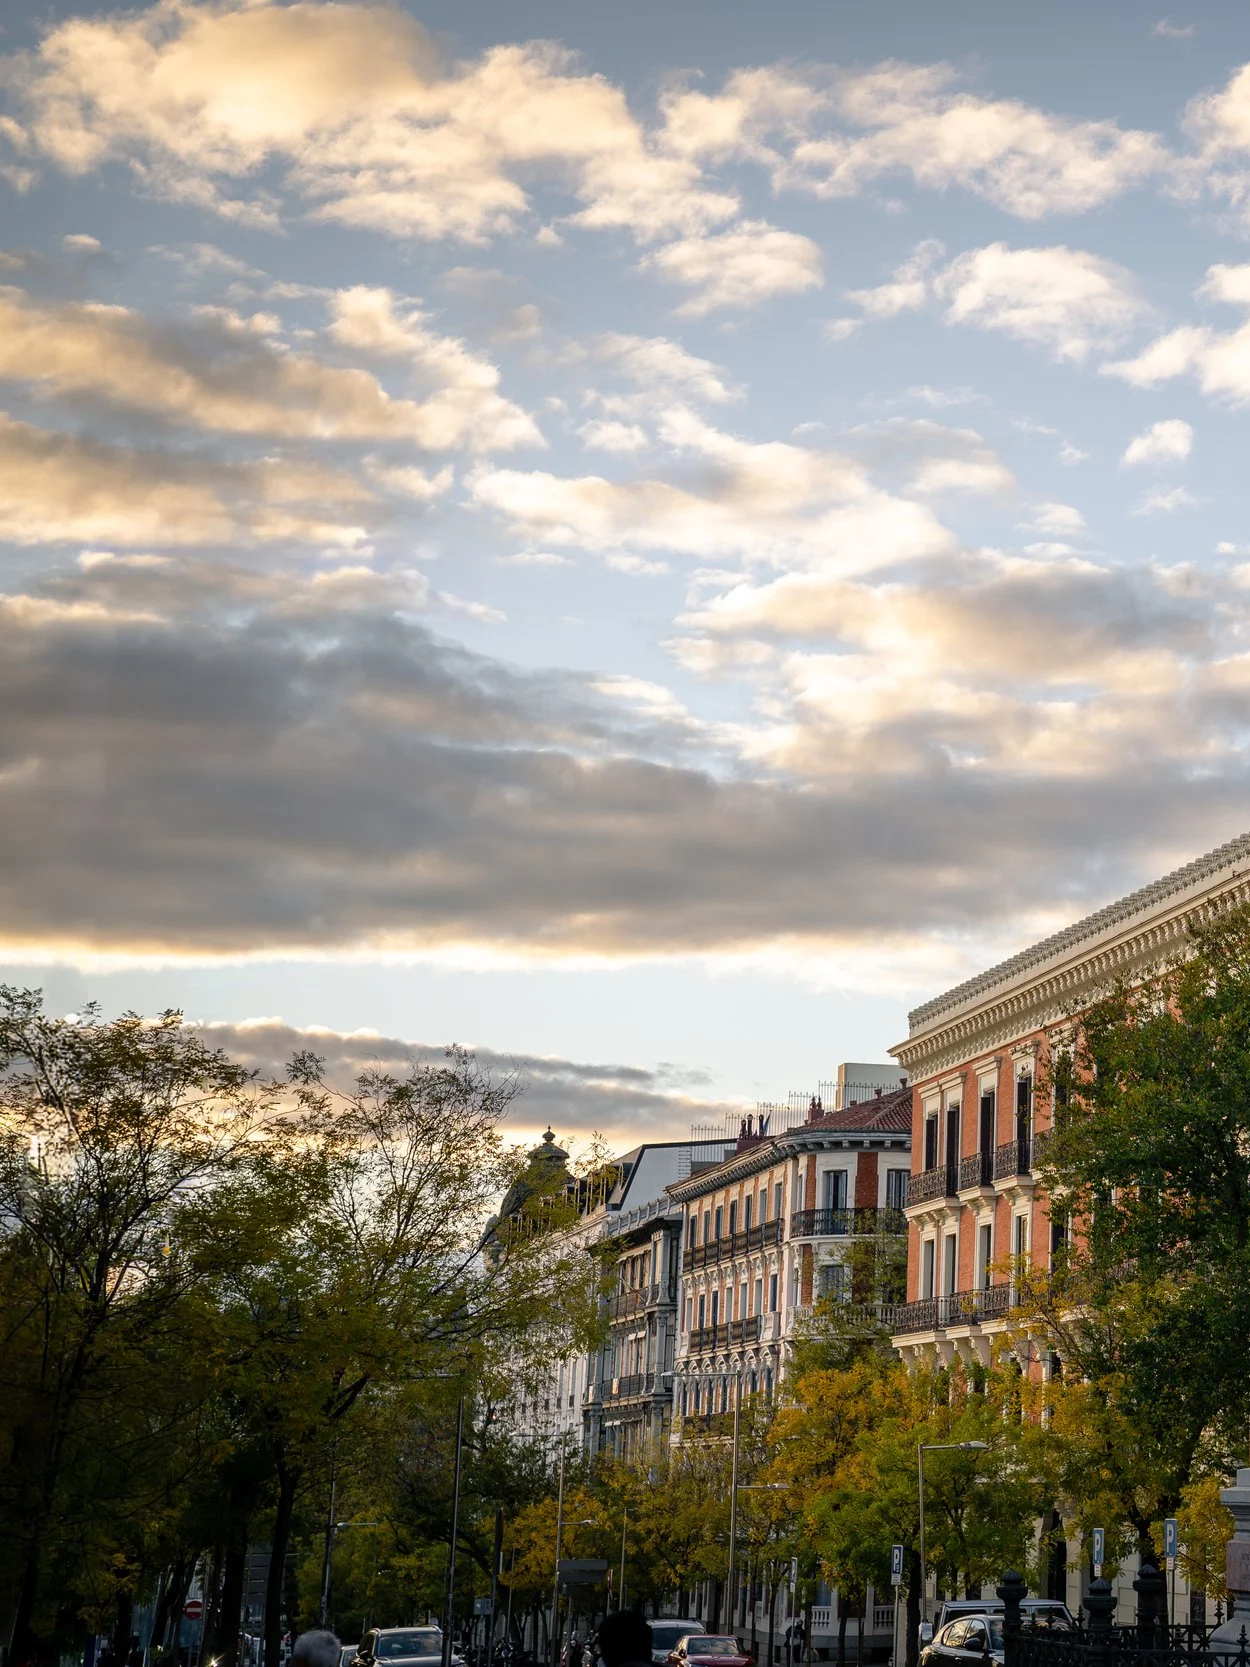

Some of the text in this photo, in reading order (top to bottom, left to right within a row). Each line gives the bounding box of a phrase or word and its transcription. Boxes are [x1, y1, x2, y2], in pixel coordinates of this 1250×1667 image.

[1094, 1533, 1101, 1561] P
[1166, 1524, 1174, 1553] P
[893, 1548, 900, 1571] P
